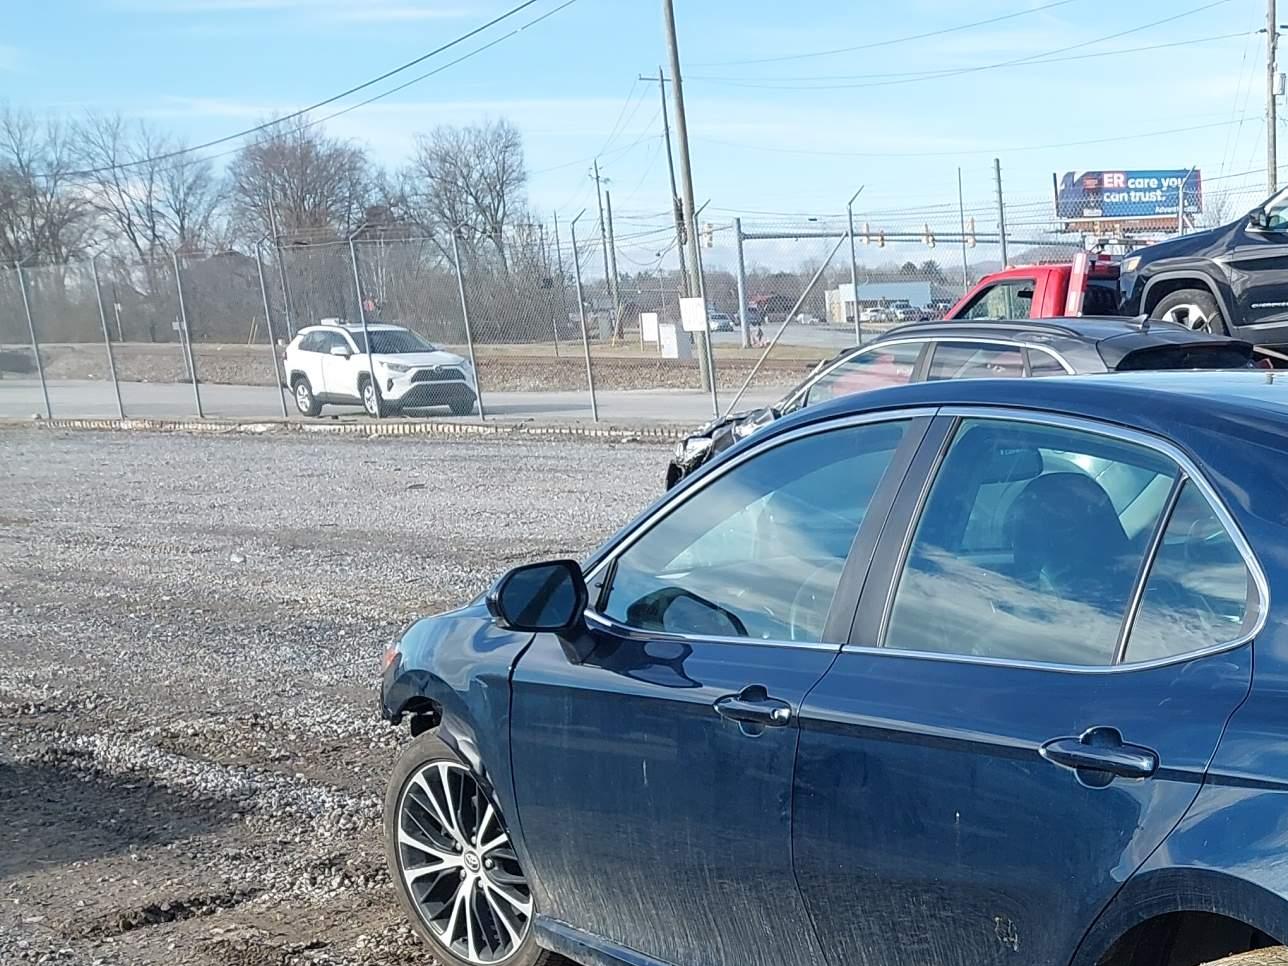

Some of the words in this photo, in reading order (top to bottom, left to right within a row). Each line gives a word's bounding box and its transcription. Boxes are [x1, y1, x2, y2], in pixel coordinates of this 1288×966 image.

[1103, 173, 1125, 187] ER
[1127, 177, 1159, 189] care
[1161, 177, 1185, 191] you
[1104, 191, 1128, 202] can
[1130, 190, 1165, 202] trust.
